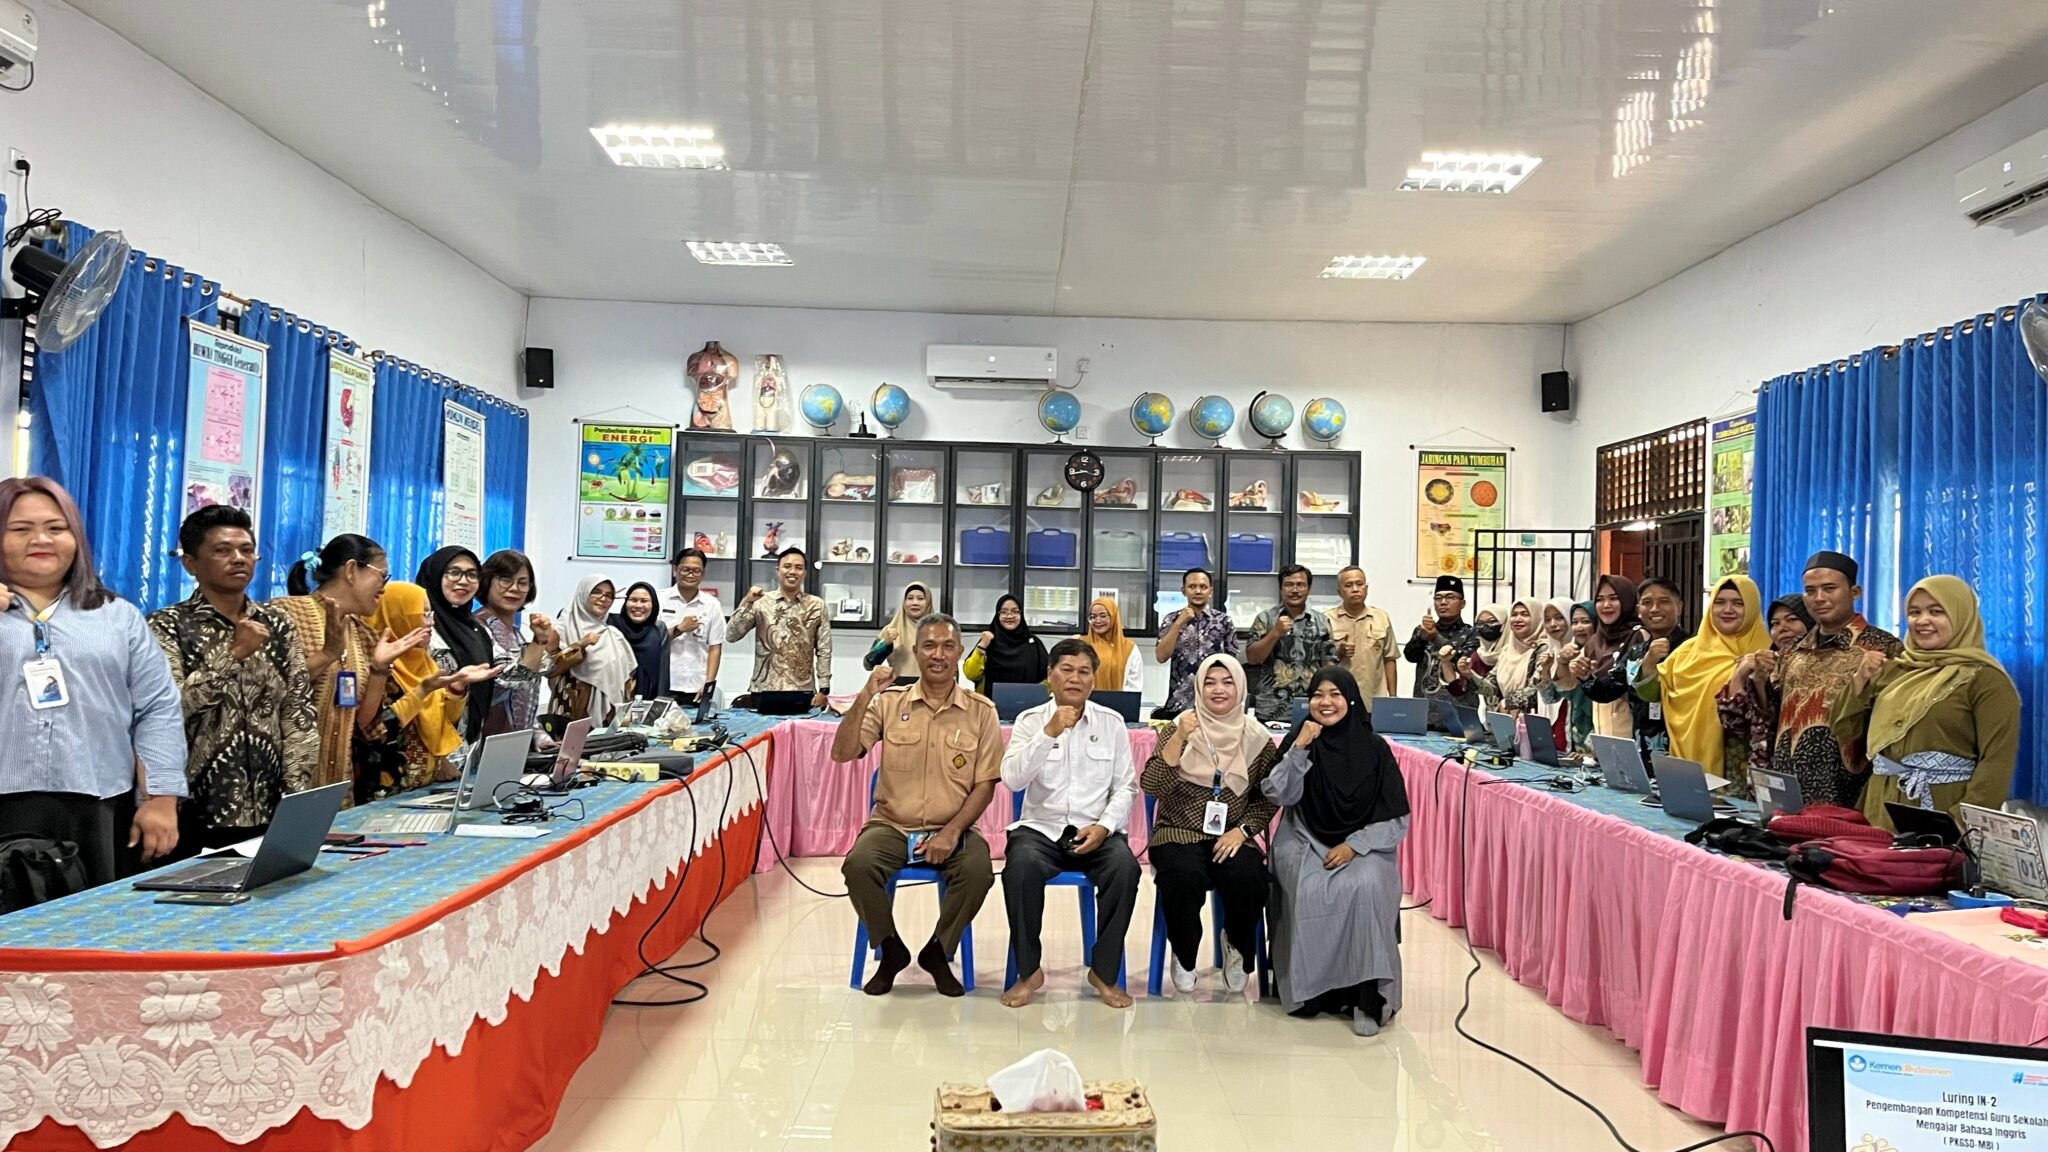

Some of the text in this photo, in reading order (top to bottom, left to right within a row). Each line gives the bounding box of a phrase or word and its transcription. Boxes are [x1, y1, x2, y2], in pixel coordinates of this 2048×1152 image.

[602, 434, 653, 443] ENERGI
[1421, 453, 1505, 467] JARINGAN PADA TUMBUHAN
[1069, 467, 1076, 475] 9
[1080, 480, 1087, 488] 6
[1942, 1091, 1997, 1107] Luring IN-2
[1866, 1099, 2048, 1127] Pengembangan Kompetensi Guru Sekolah
[1916, 1119, 2027, 1140] Mengajar Bahasa Inggris
